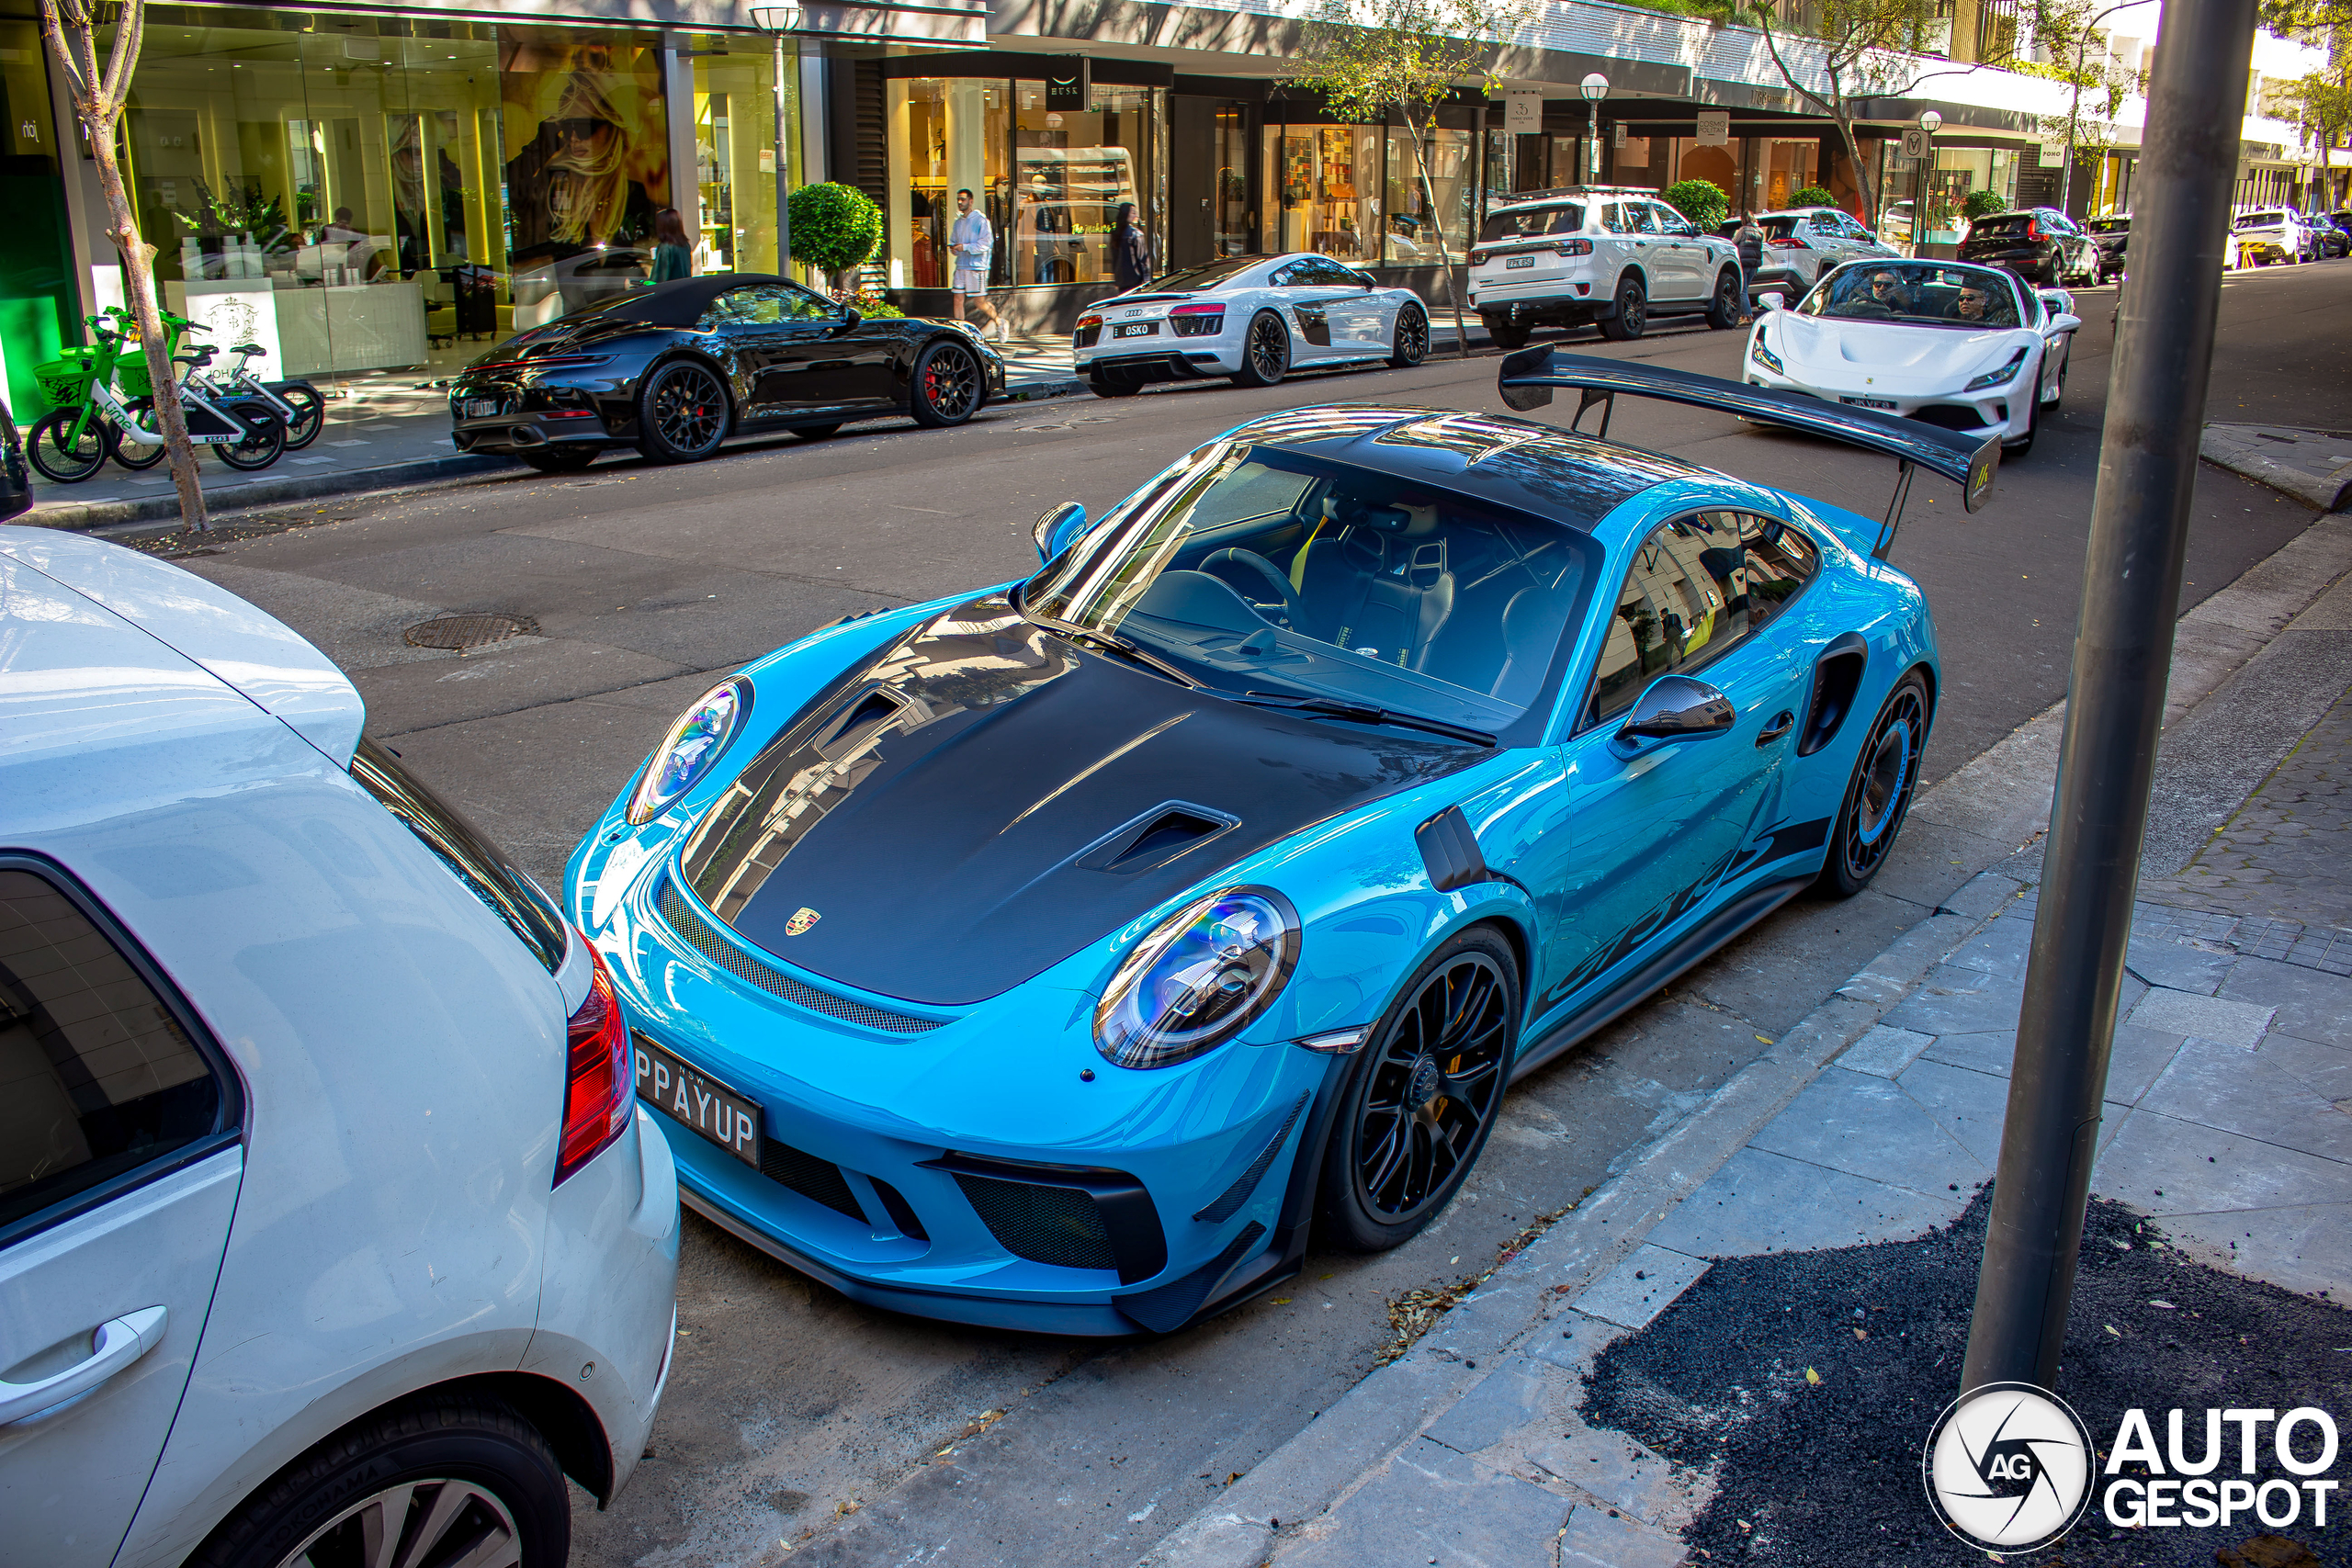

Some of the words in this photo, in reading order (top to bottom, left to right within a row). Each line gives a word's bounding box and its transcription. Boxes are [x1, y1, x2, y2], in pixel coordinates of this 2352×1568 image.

[104, 400, 132, 431] Lime
[1881, 753, 1908, 824] PORSCHE
[635, 1047, 753, 1152] PPAYUP
[679, 1066, 705, 1086] NSW
[264, 1464, 379, 1550] YOKOHAMA
